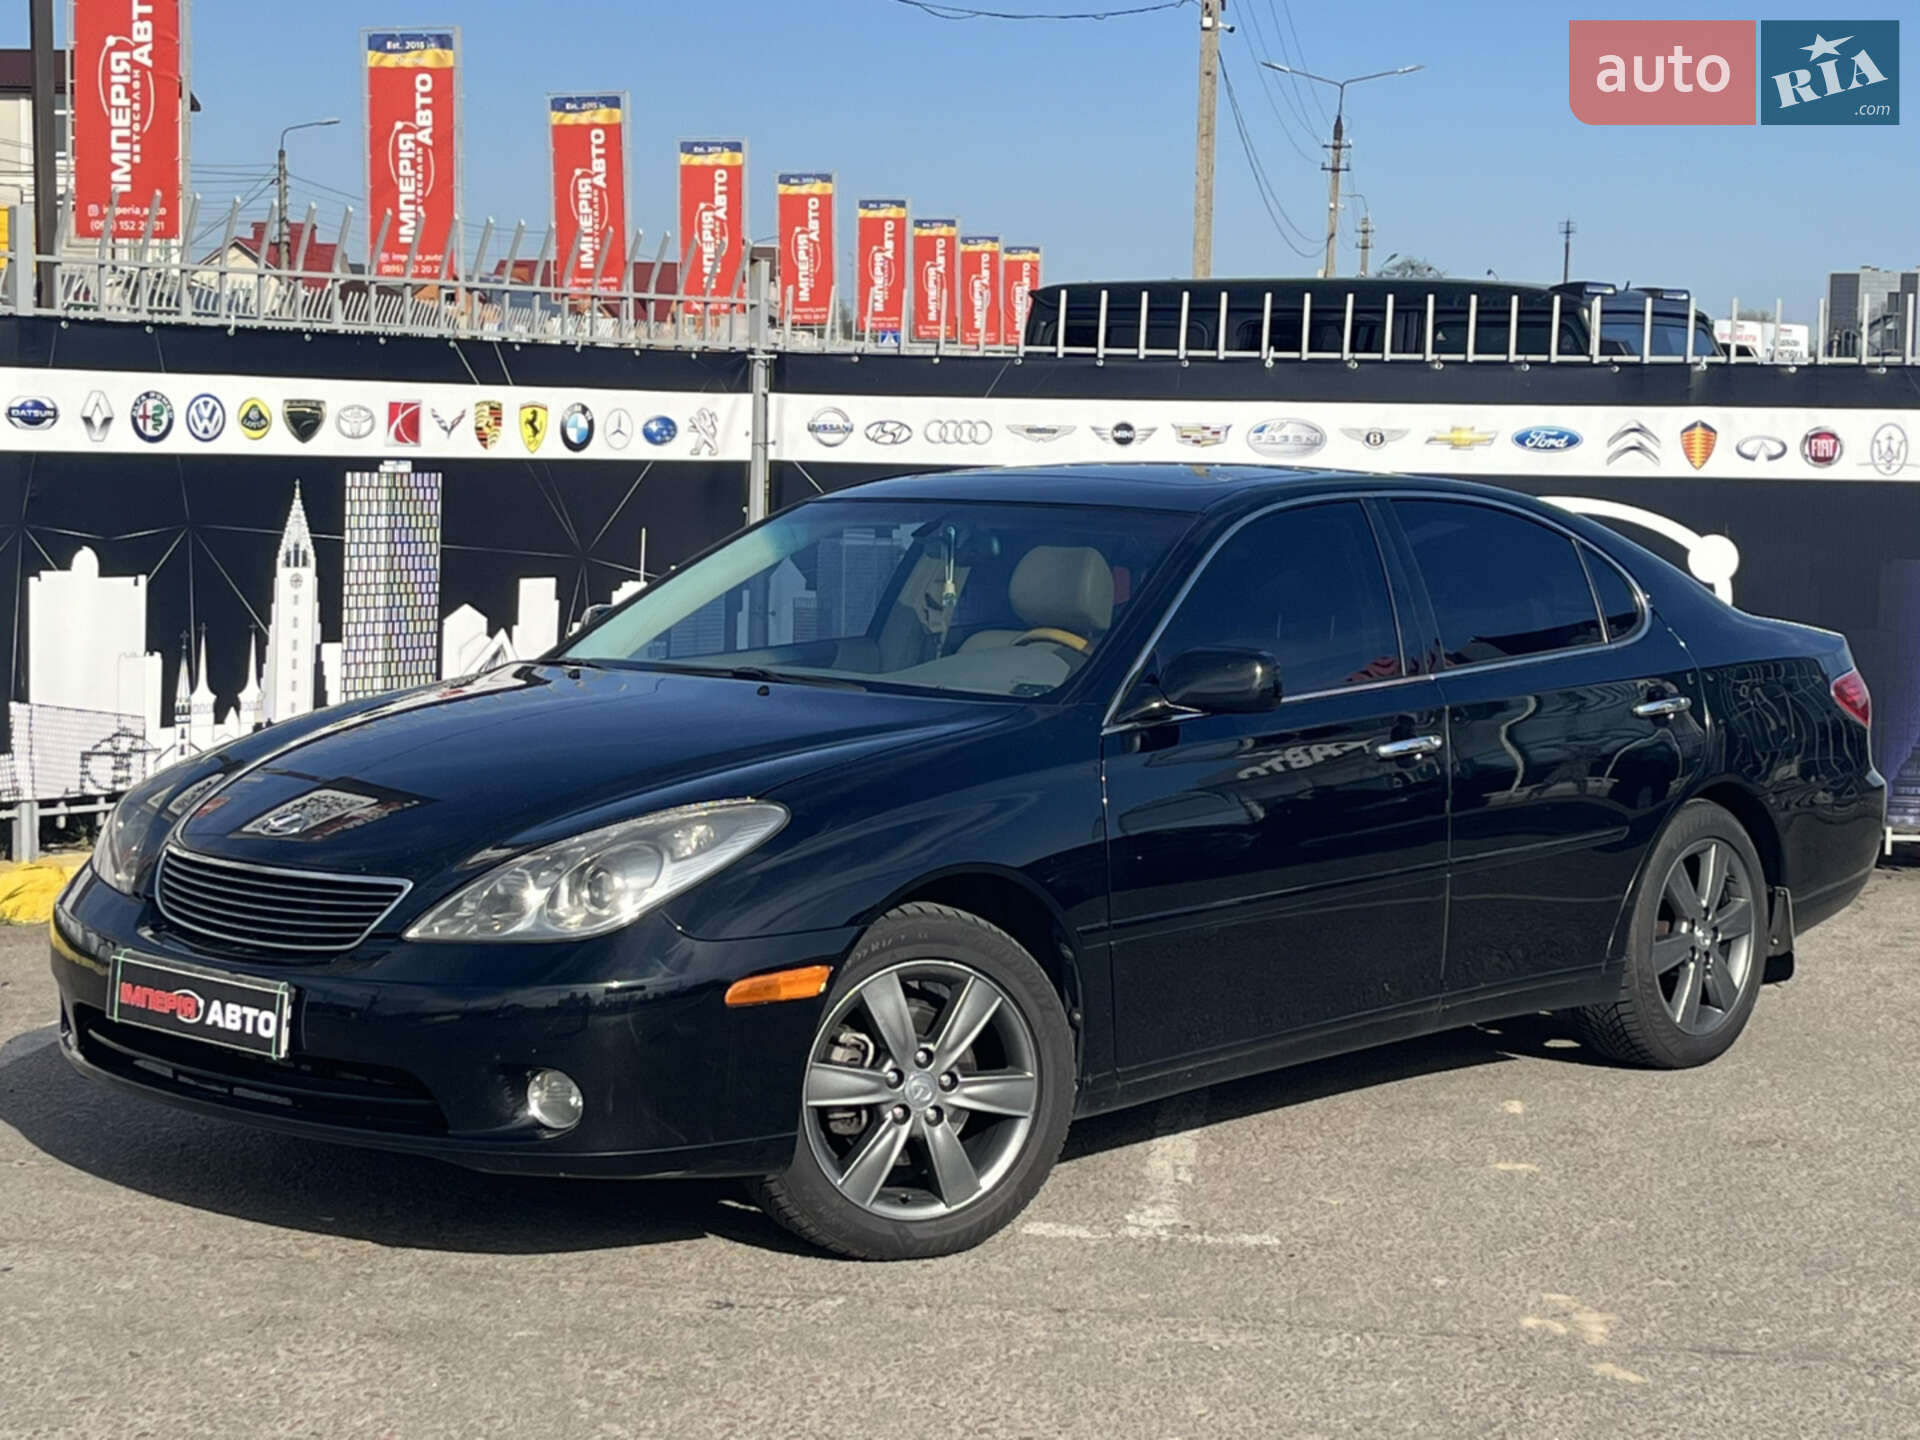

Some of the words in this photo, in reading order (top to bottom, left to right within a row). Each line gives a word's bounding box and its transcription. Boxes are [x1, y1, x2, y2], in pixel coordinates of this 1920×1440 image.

[415, 73, 433, 146] АВТО
[590, 128, 607, 188] АВТО
[399, 133, 416, 243] ІМПЕРІЯ
[714, 169, 728, 221] АВТО
[808, 197, 820, 243] АВТО
[10, 408, 55, 418] DATSUN
[810, 422, 851, 433] NISSAN
[1525, 430, 1570, 448] Ford
[1811, 439, 1836, 458] FIAT
[120, 982, 197, 1018] ІМПЕРІЯ
[206, 1000, 276, 1038] АВТО
